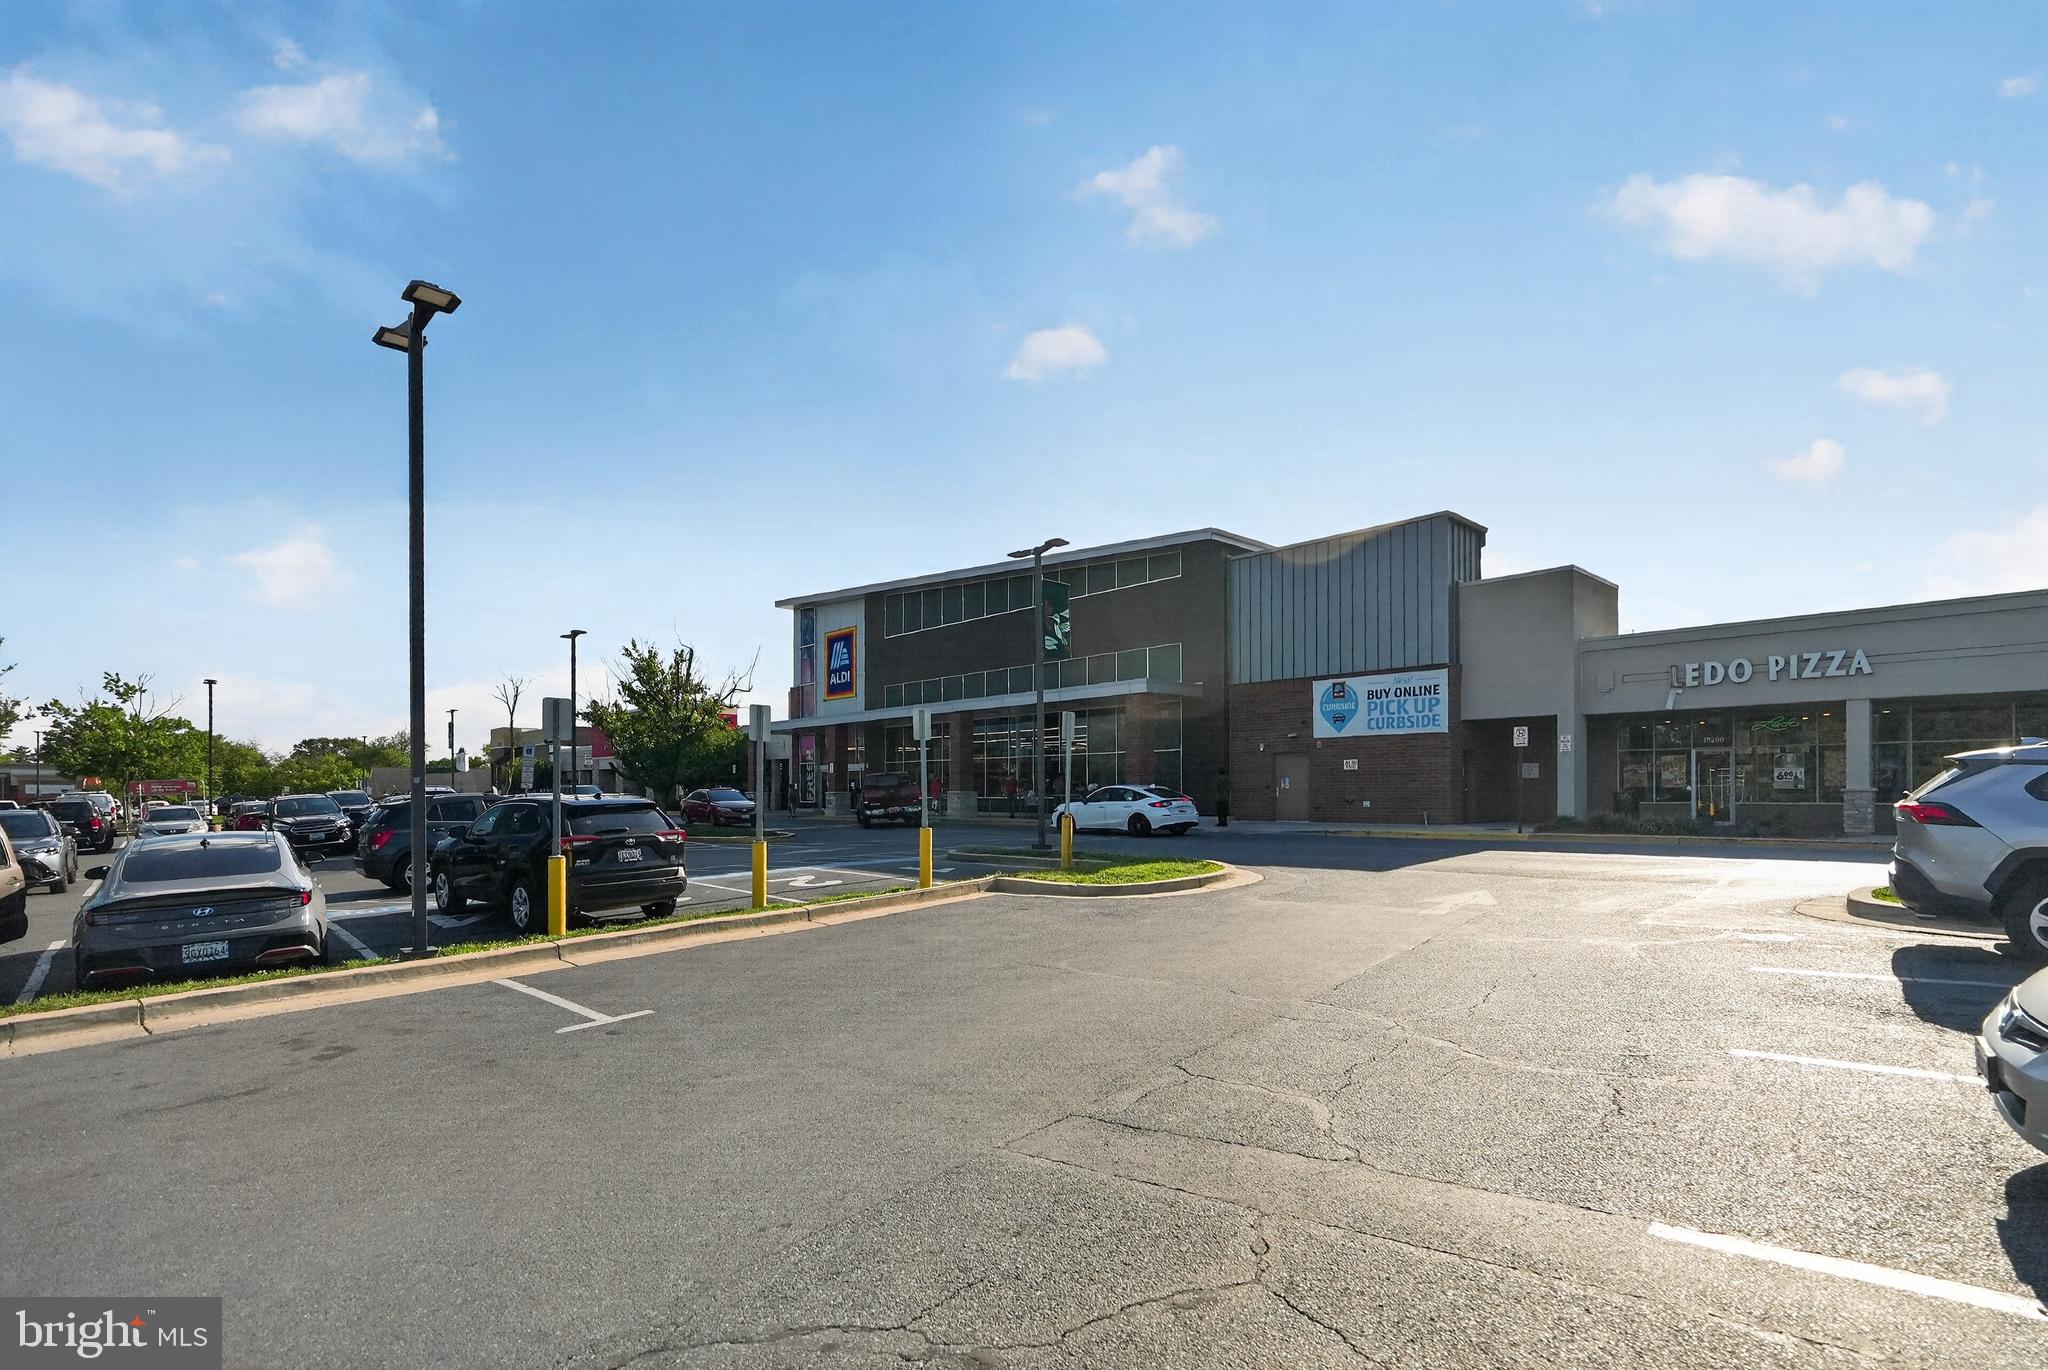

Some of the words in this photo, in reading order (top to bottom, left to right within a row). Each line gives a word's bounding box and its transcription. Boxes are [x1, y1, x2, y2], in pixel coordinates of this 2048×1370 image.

[1768, 649, 1873, 681] PIZZA
[829, 670, 850, 685] ALDI
[1367, 688, 1391, 700] BUY
[1394, 684, 1440, 699] ONLINE
[1322, 701, 1356, 711] CURBSIDE
[1367, 699, 1411, 717] PICK
[1413, 697, 1440, 714] UP
[1367, 714, 1440, 730] CURBSIDE
